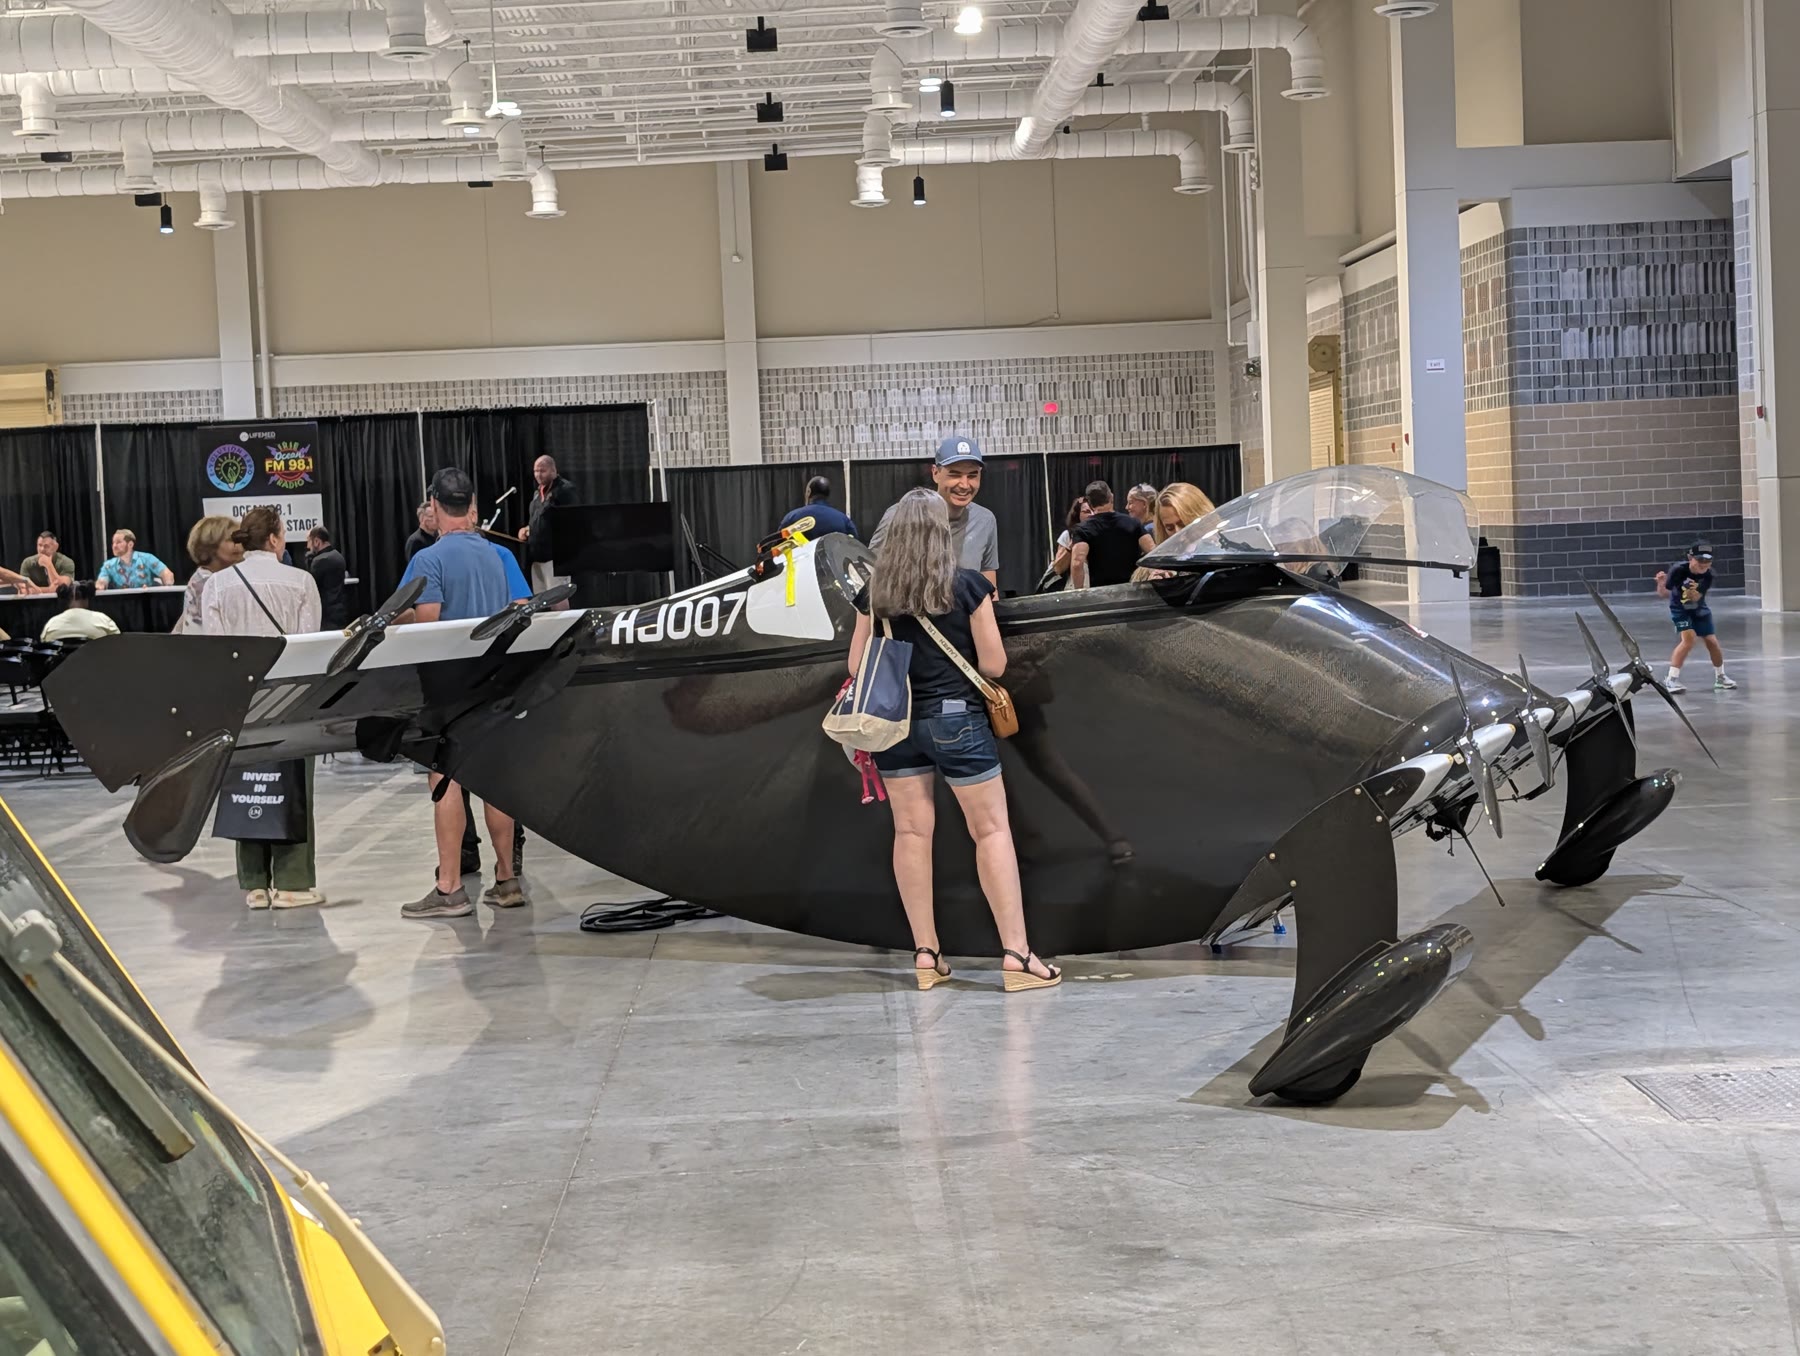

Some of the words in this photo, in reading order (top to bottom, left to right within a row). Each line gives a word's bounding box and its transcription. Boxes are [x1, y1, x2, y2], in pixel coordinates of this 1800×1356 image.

[249, 431, 276, 439] LIFEMED
[265, 460, 285, 472] FM
[288, 457, 314, 472] 98.1
[276, 479, 305, 490] RADIO
[286, 518, 318, 532] STAGE
[611, 591, 747, 645] HJ007
[242, 771, 281, 782] INVEST
[253, 783, 267, 793] IN
[231, 793, 285, 805] YOURSELF
